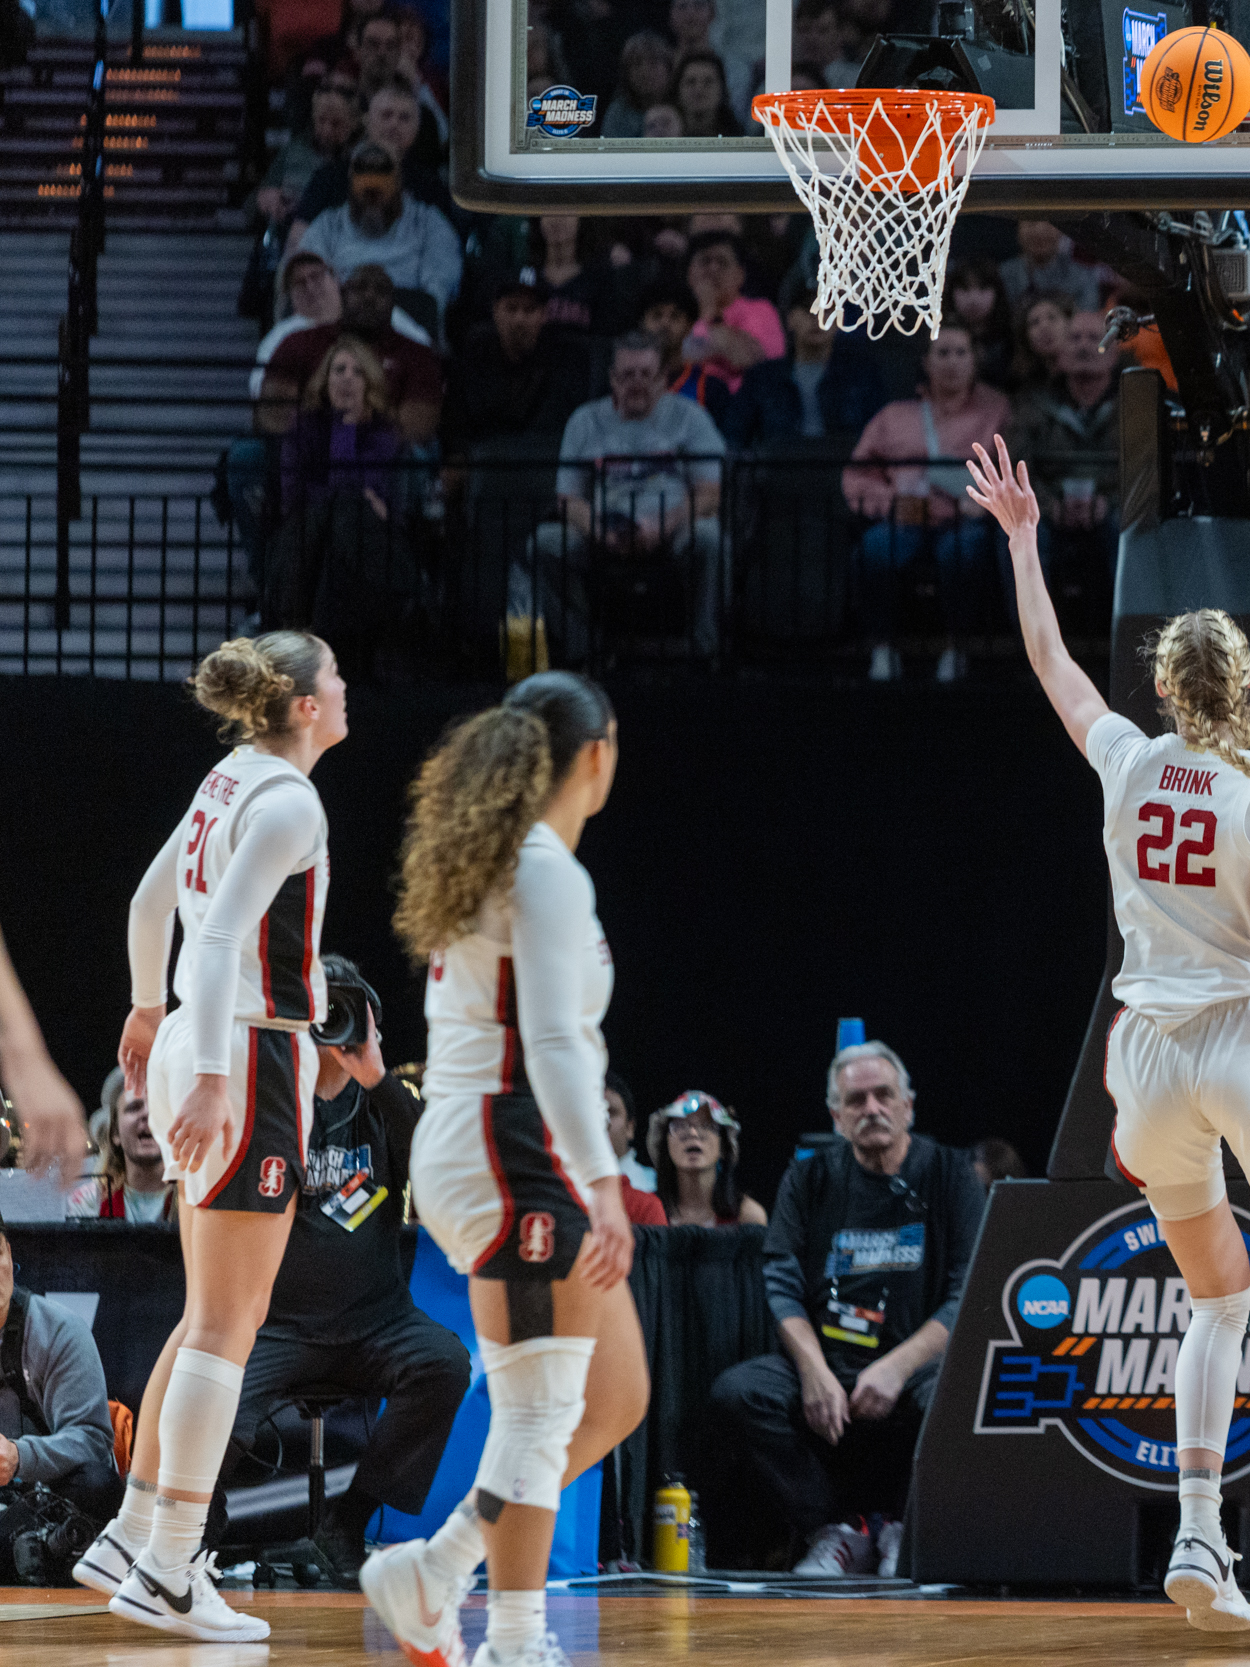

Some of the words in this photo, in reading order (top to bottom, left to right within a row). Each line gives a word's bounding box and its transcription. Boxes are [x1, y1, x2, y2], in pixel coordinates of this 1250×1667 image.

[541, 99, 578, 111] MARCH
[1192, 59, 1224, 131] Wilson
[544, 110, 594, 122] MADNESS
[1158, 764, 1219, 796] BRINK
[185, 809, 219, 894] 21
[1136, 801, 1218, 888] 22
[1023, 1300, 1070, 1317] NCAA
